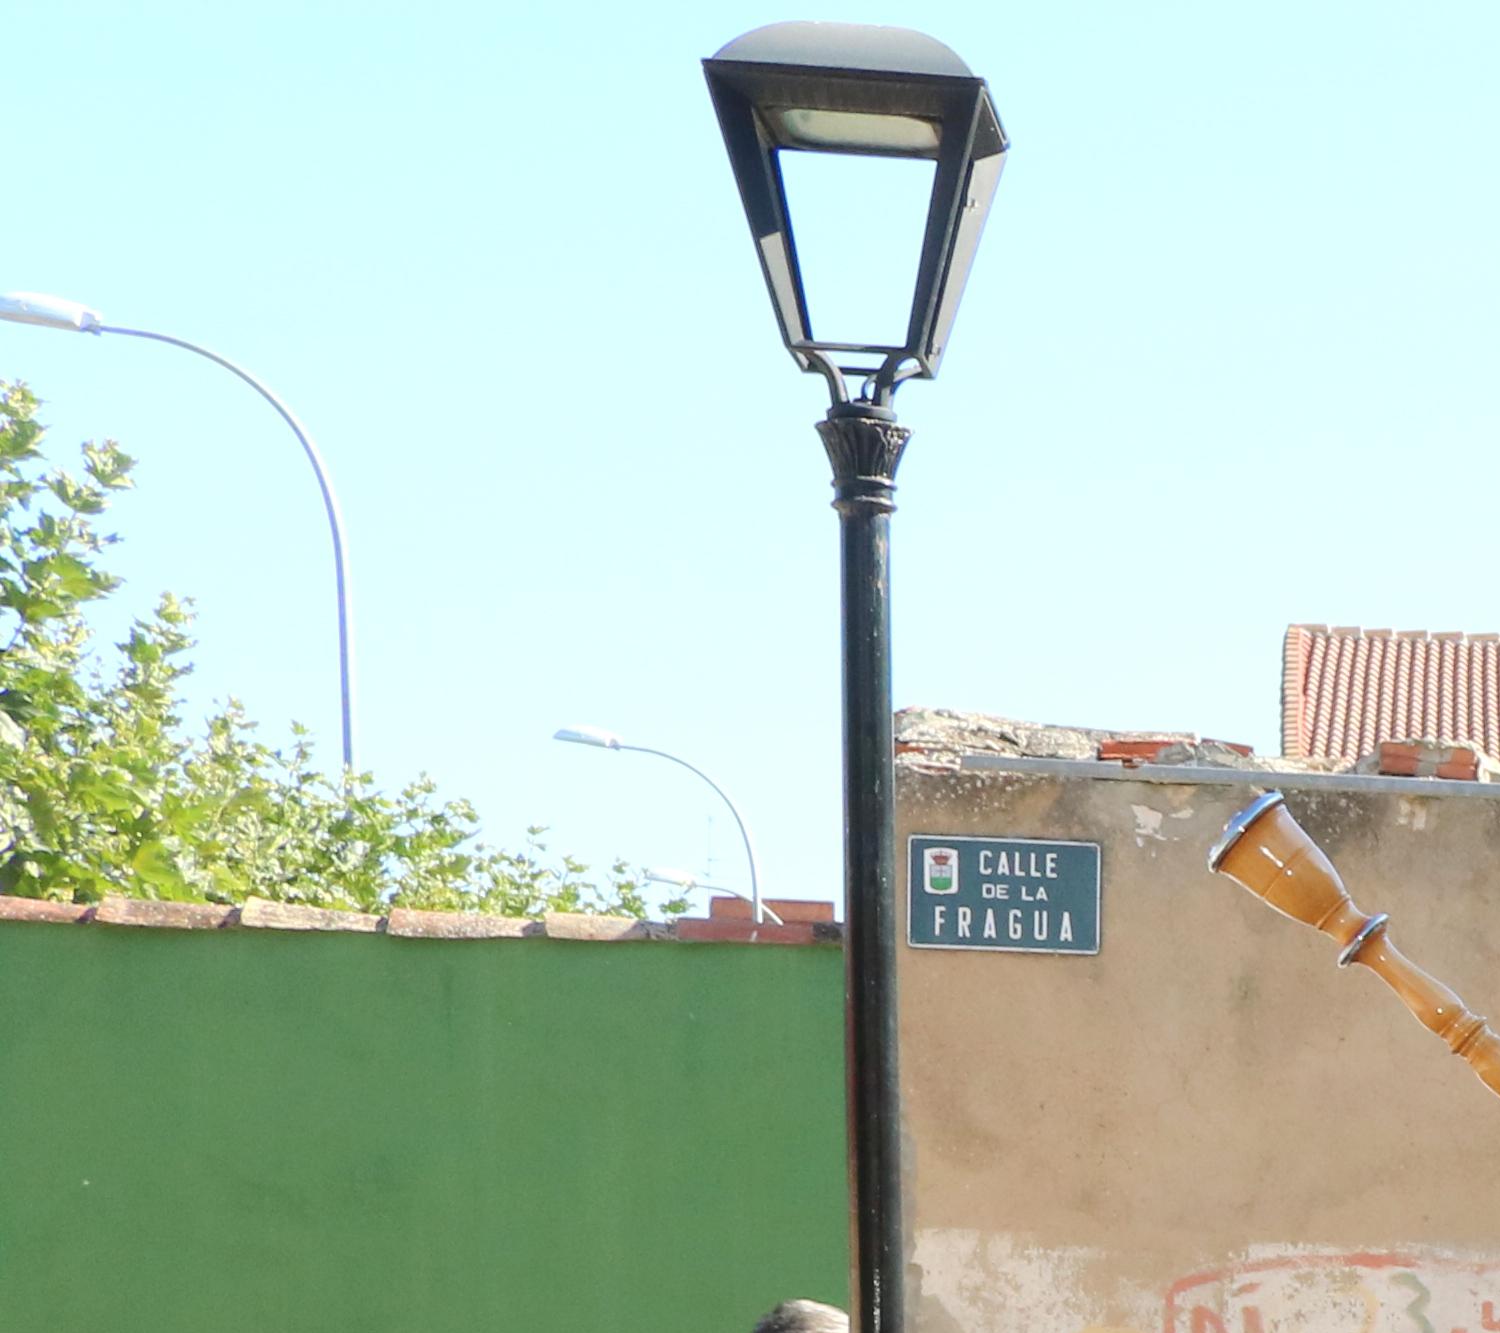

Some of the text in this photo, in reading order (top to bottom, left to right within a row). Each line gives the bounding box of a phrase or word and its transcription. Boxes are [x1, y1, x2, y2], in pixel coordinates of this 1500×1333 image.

[979, 850, 1058, 878] CALLE
[982, 884, 1048, 901] DE LA
[934, 905, 1073, 942] FRAGUA
